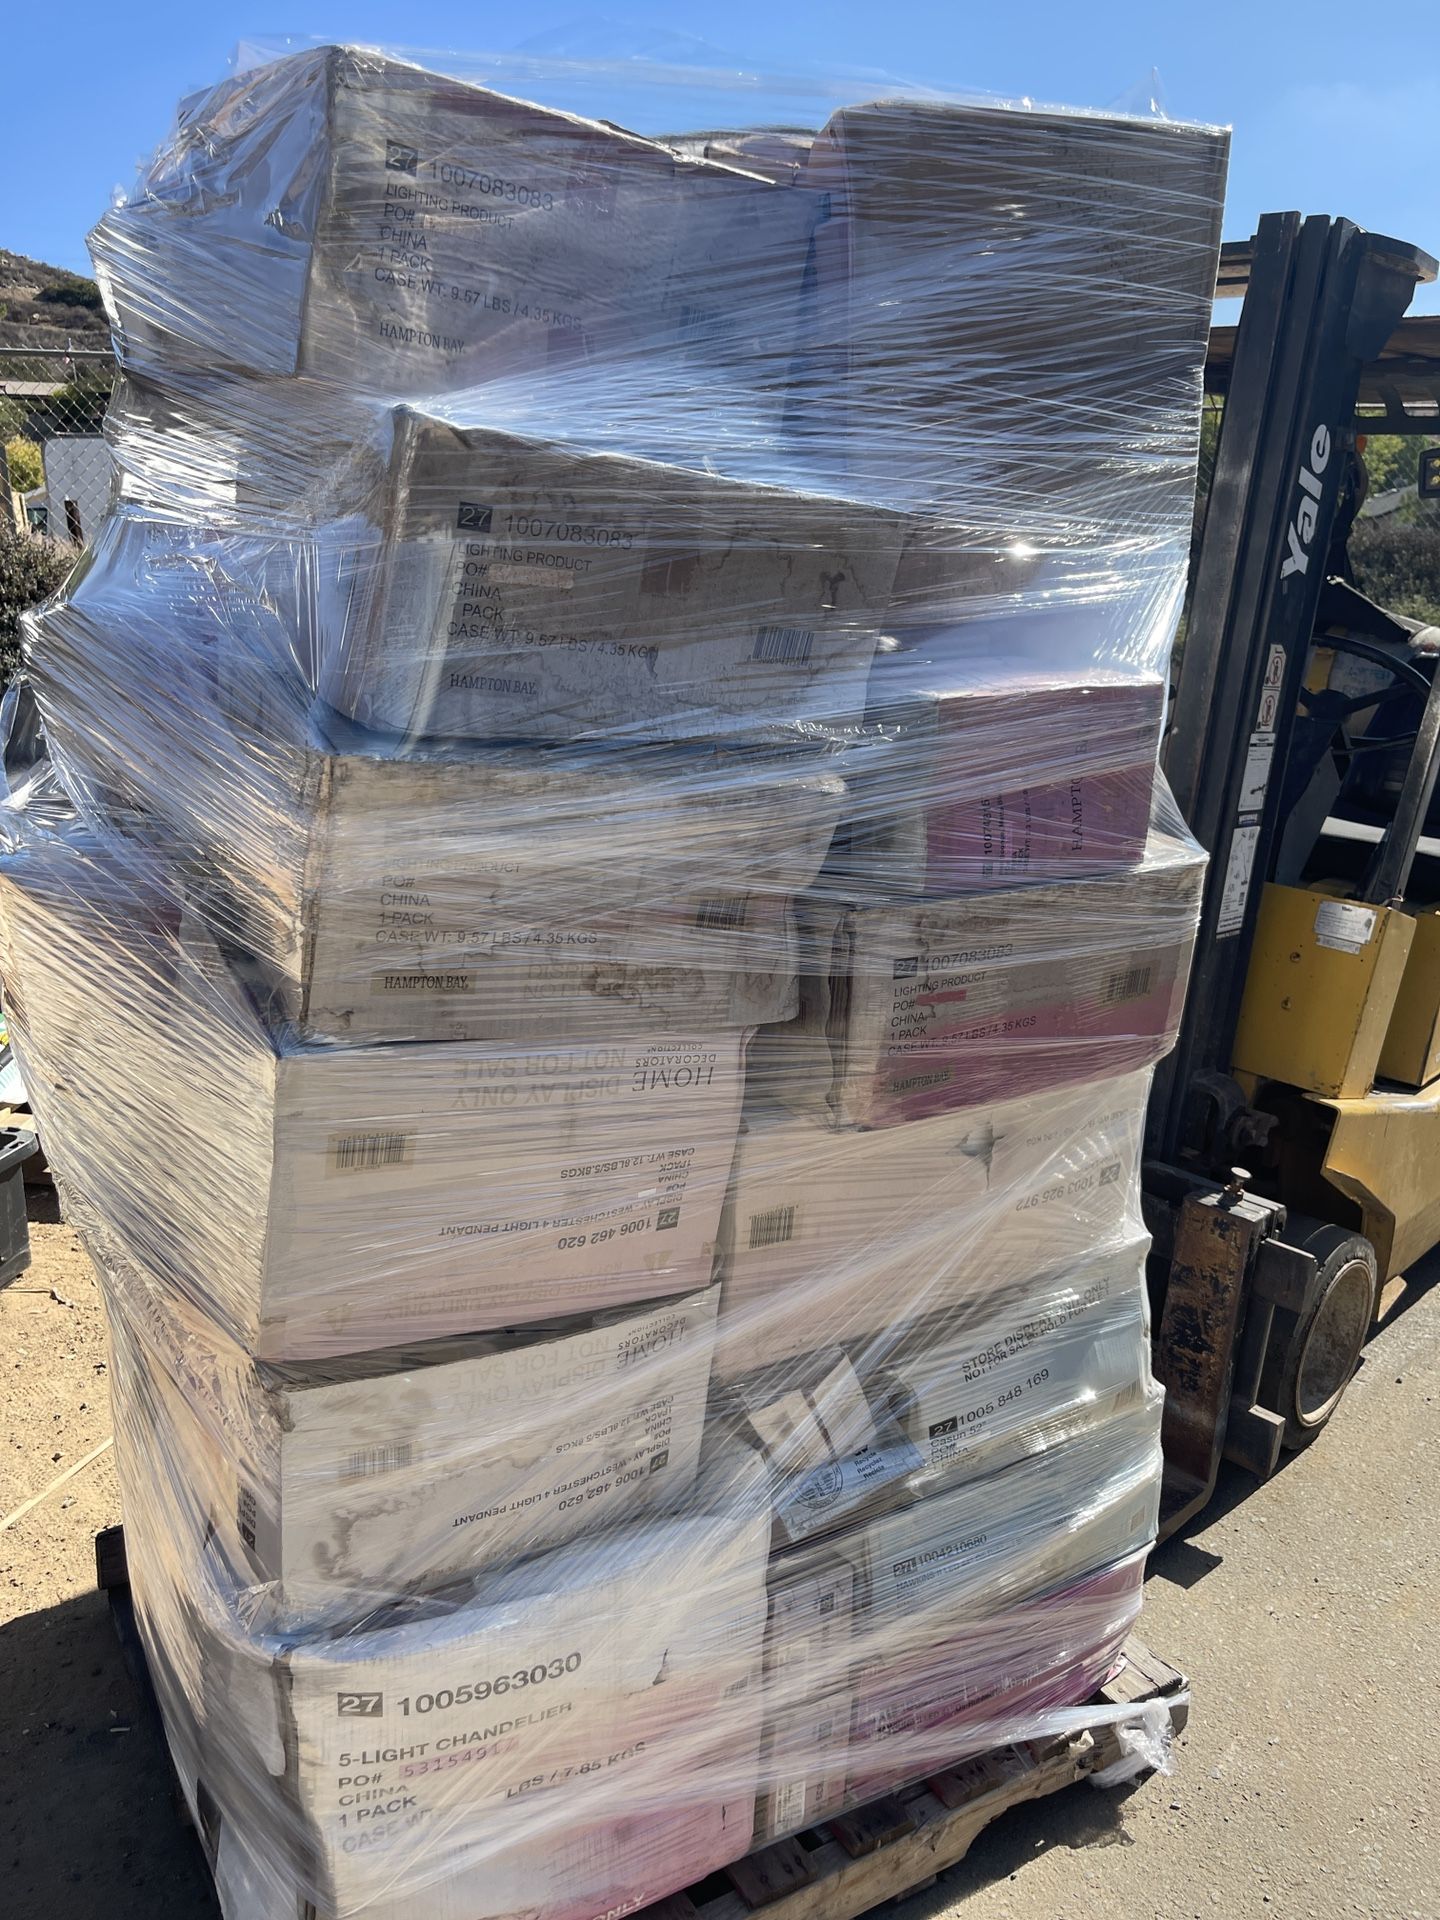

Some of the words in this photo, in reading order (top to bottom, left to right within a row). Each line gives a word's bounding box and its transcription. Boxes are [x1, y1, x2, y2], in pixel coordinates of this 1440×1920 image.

[388, 140, 417, 175] 27
[429, 163, 554, 212] 1007083083
[383, 203, 415, 225] PO#
[386, 183, 448, 216] LIGHTING
[451, 196, 515, 230] PRODUCT
[380, 226, 428, 251] CHINA
[389, 249, 433, 273] PACK
[374, 268, 417, 291] CASE
[420, 278, 448, 299] WT:
[449, 285, 482, 307] 9.57
[483, 292, 512, 315] LBS
[520, 302, 552, 325] 4.35
[553, 308, 583, 331] KGS
[378, 321, 441, 349] HAMPTON
[1280, 424, 1331, 581] Yale
[457, 502, 493, 533] 27
[505, 515, 634, 551] 1007083083
[458, 541, 523, 565] LIGHTING
[526, 550, 593, 572] PRODUCT
[455, 561, 488, 578] PO#
[451, 582, 501, 600] CHINA
[462, 603, 505, 621] PACK
[446, 621, 490, 639] CASE
[450, 673, 509, 693] HAMPTON
[382, 875, 415, 889] PO#
[380, 893, 431, 908] CHINA
[391, 911, 435, 926] PACK
[375, 930, 422, 945] CASE
[424, 930, 453, 945] WT:
[533, 932, 565, 946] 4.35
[565, 932, 598, 946] KGS
[384, 974, 444, 991] HAMPTON
[445, 974, 467, 991] BAY
[894, 978, 939, 998] LIGHTING
[940, 971, 987, 992] PRODUCT
[892, 999, 916, 1013] PO#
[890, 1011, 926, 1029] CHINA
[991, 1020, 1014, 1037] 4.35
[1014, 1015, 1037, 1031] KGS
[898, 1024, 928, 1041] PACK
[453, 1057, 520, 1080] SALE
[525, 1050, 573, 1075] FOR
[635, 1053, 717, 1068] DECORATORS
[631, 1066, 714, 1092] HOME
[893, 1072, 931, 1093] HAMPTON
[646, 1151, 666, 1163] WT:
[666, 1147, 696, 1159] CASE
[657, 1171, 690, 1184] CHINA
[1066, 1176, 1094, 1196] 1003
[1015, 1193, 1039, 1212] 972
[1041, 1185, 1064, 1203] 925
[501, 1220, 540, 1232] LIGHT
[552, 1204, 634, 1228] WESTCHESTER
[620, 1216, 652, 1237] 1006
[438, 1223, 500, 1237] PENDANT
[590, 1227, 617, 1245] 462
[557, 1235, 587, 1251] 620
[618, 1316, 688, 1351] DECORATORS
[961, 1340, 1003, 1374] STORE
[1083, 1276, 1111, 1301] ONLY
[615, 1328, 685, 1371] HOME
[514, 1350, 561, 1375] FOR
[447, 1361, 508, 1391] SALE
[516, 1359, 607, 1400] DISPLAY
[964, 1365, 988, 1384] NOT
[929, 1415, 959, 1440] 27
[959, 1400, 996, 1426] 1005
[997, 1384, 1023, 1408] 848
[1025, 1368, 1050, 1390] 169
[644, 1416, 673, 1434] CHINA
[652, 1427, 672, 1439] PO#
[632, 1437, 672, 1463] DISPLAY
[930, 1431, 967, 1448] Casun
[930, 1443, 957, 1457] PO#
[854, 1451, 877, 1467] Recycle
[551, 1459, 628, 1496] WESTCHESTER
[585, 1480, 613, 1500] 462
[508, 1493, 543, 1512] LIGHT
[557, 1491, 585, 1512] 620
[451, 1504, 507, 1529] PENDANT
[338, 1692, 383, 1717] 27
[396, 1651, 583, 1717] 1005963030
[338, 1742, 431, 1768] 5-LIGHT
[435, 1700, 574, 1752] CHANDELIER
[337, 1772, 383, 1790] PO#
[505, 1774, 545, 1799] LBS
[563, 1758, 602, 1782] 7.85
[338, 1784, 410, 1808] CHINA
[338, 1812, 350, 1829] 1
[356, 1794, 418, 1825] PACK
[341, 1823, 399, 1854] CASE
